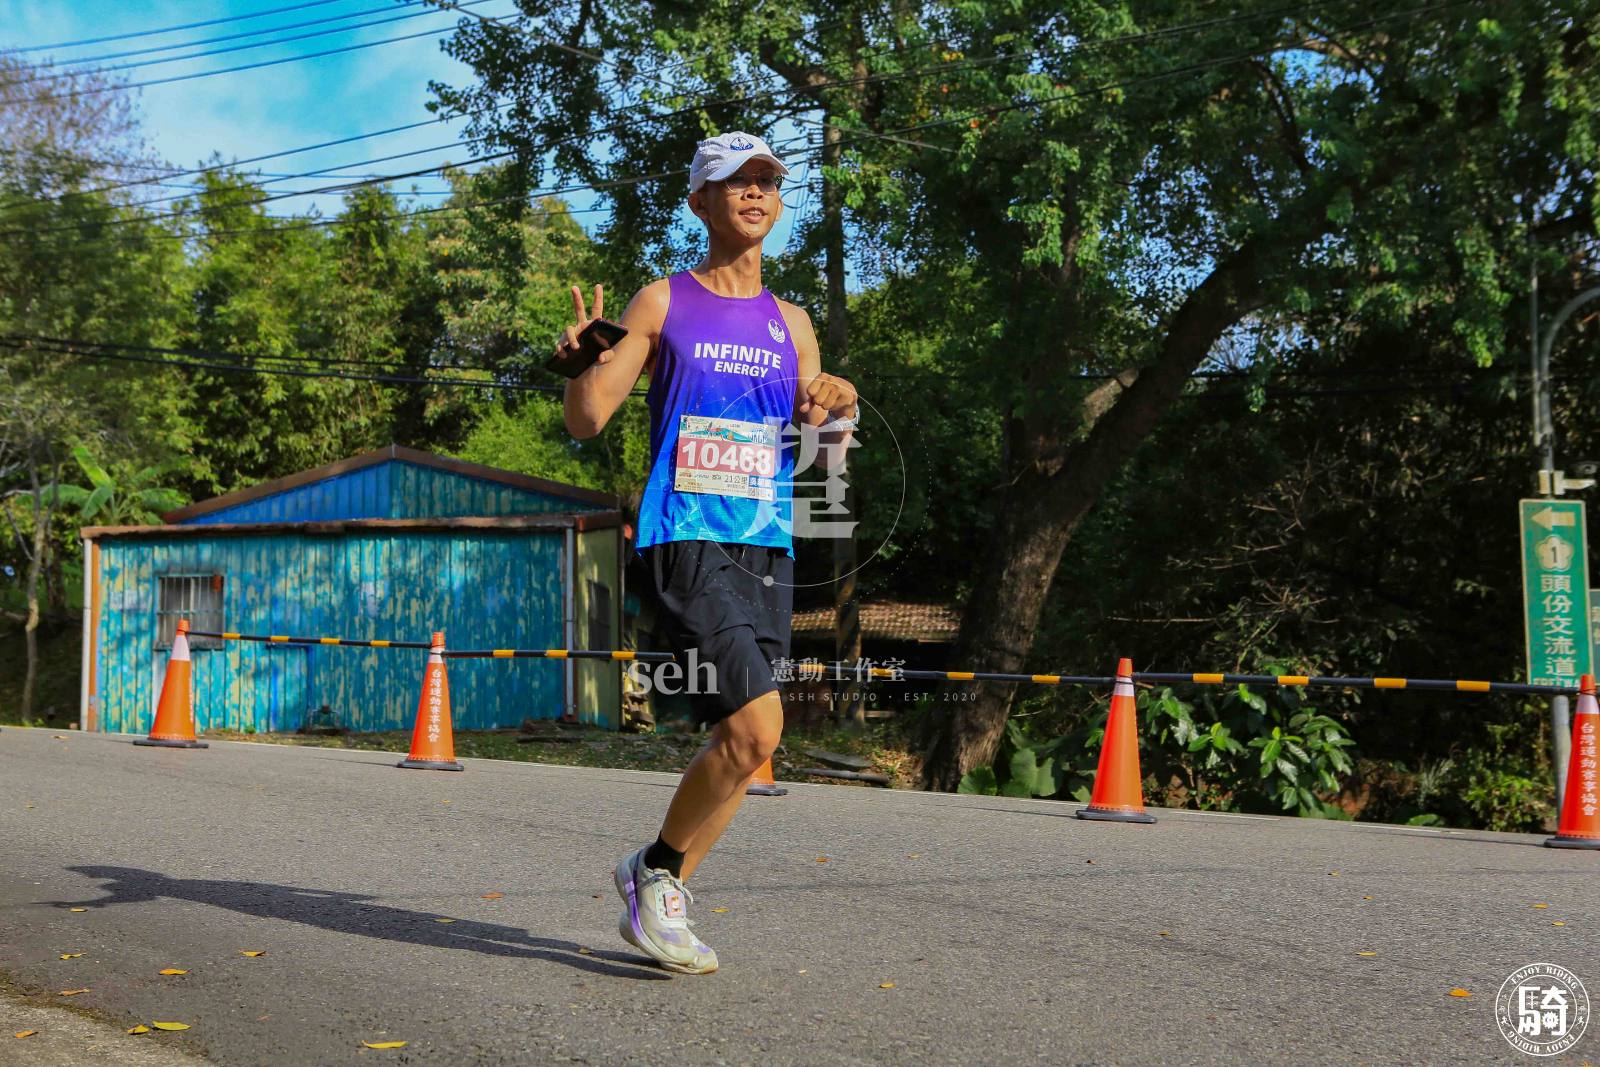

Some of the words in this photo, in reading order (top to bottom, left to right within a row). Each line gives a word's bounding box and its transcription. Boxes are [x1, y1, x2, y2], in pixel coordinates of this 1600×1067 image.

[694, 342, 782, 369] INFINITE
[714, 361, 768, 378] ENERGY
[682, 441, 772, 475] 10468
[1551, 546, 1558, 563] 1
[1540, 574, 1577, 677] 頭份交流道
